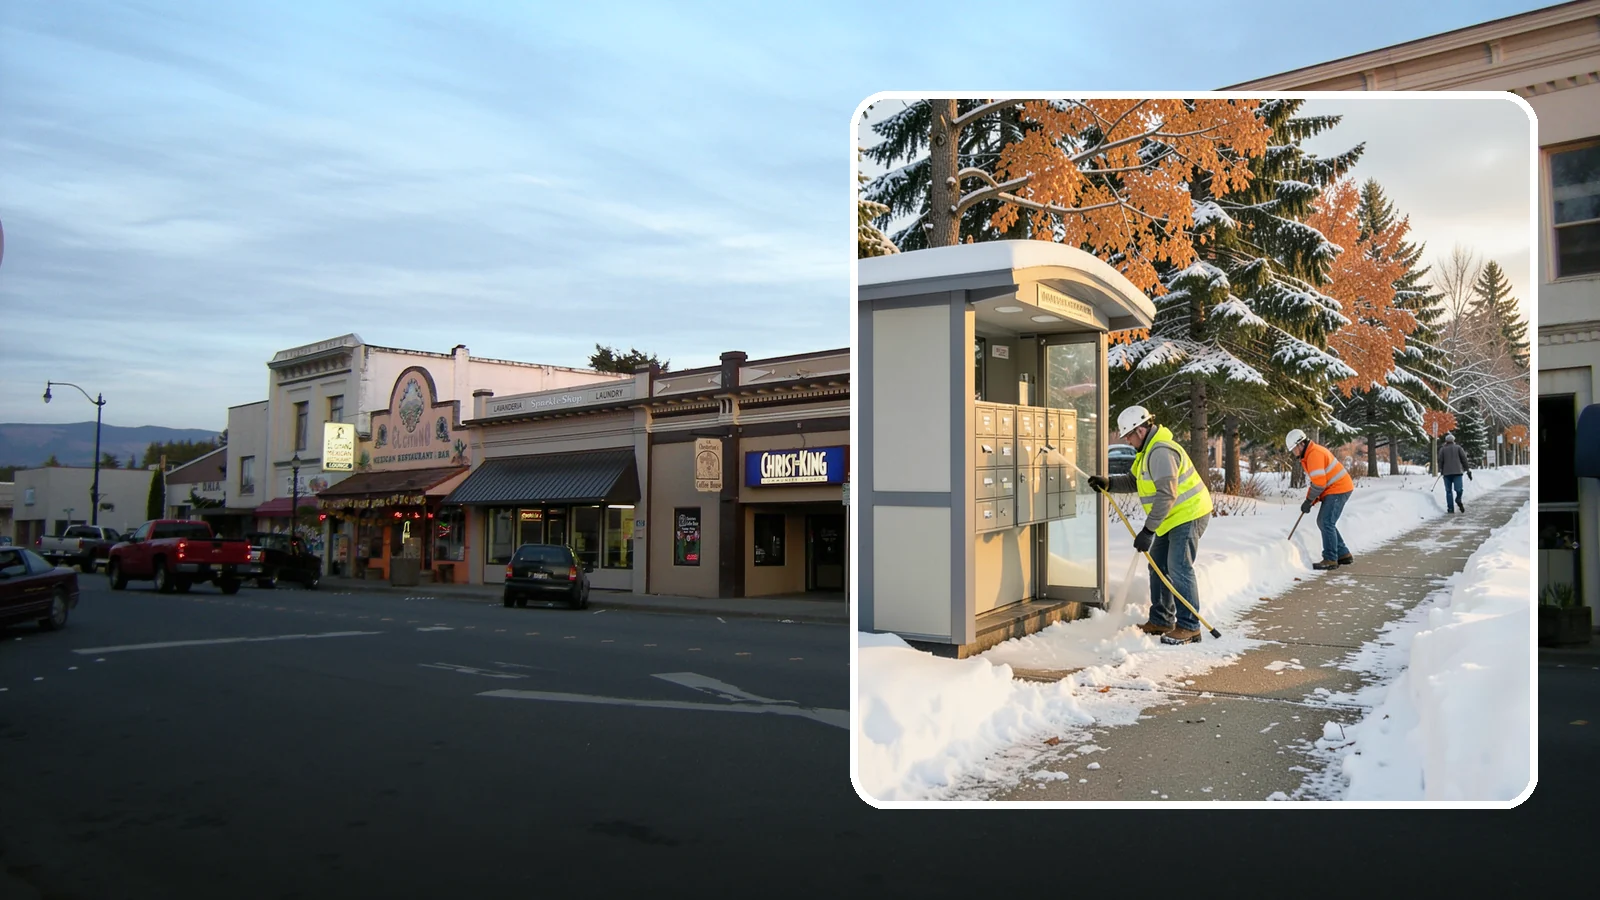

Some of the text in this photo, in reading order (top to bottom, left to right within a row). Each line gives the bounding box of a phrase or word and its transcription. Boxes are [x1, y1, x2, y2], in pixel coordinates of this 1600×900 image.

[595, 389, 623, 400] LAUNDRY
[493, 402, 523, 413] LAVANDERIA
[530, 394, 582, 409] Sparkle Shop
[398, 452, 433, 462] RESTAURANT
[438, 450, 449, 458] BAR
[761, 450, 827, 477] CHRIST KING
